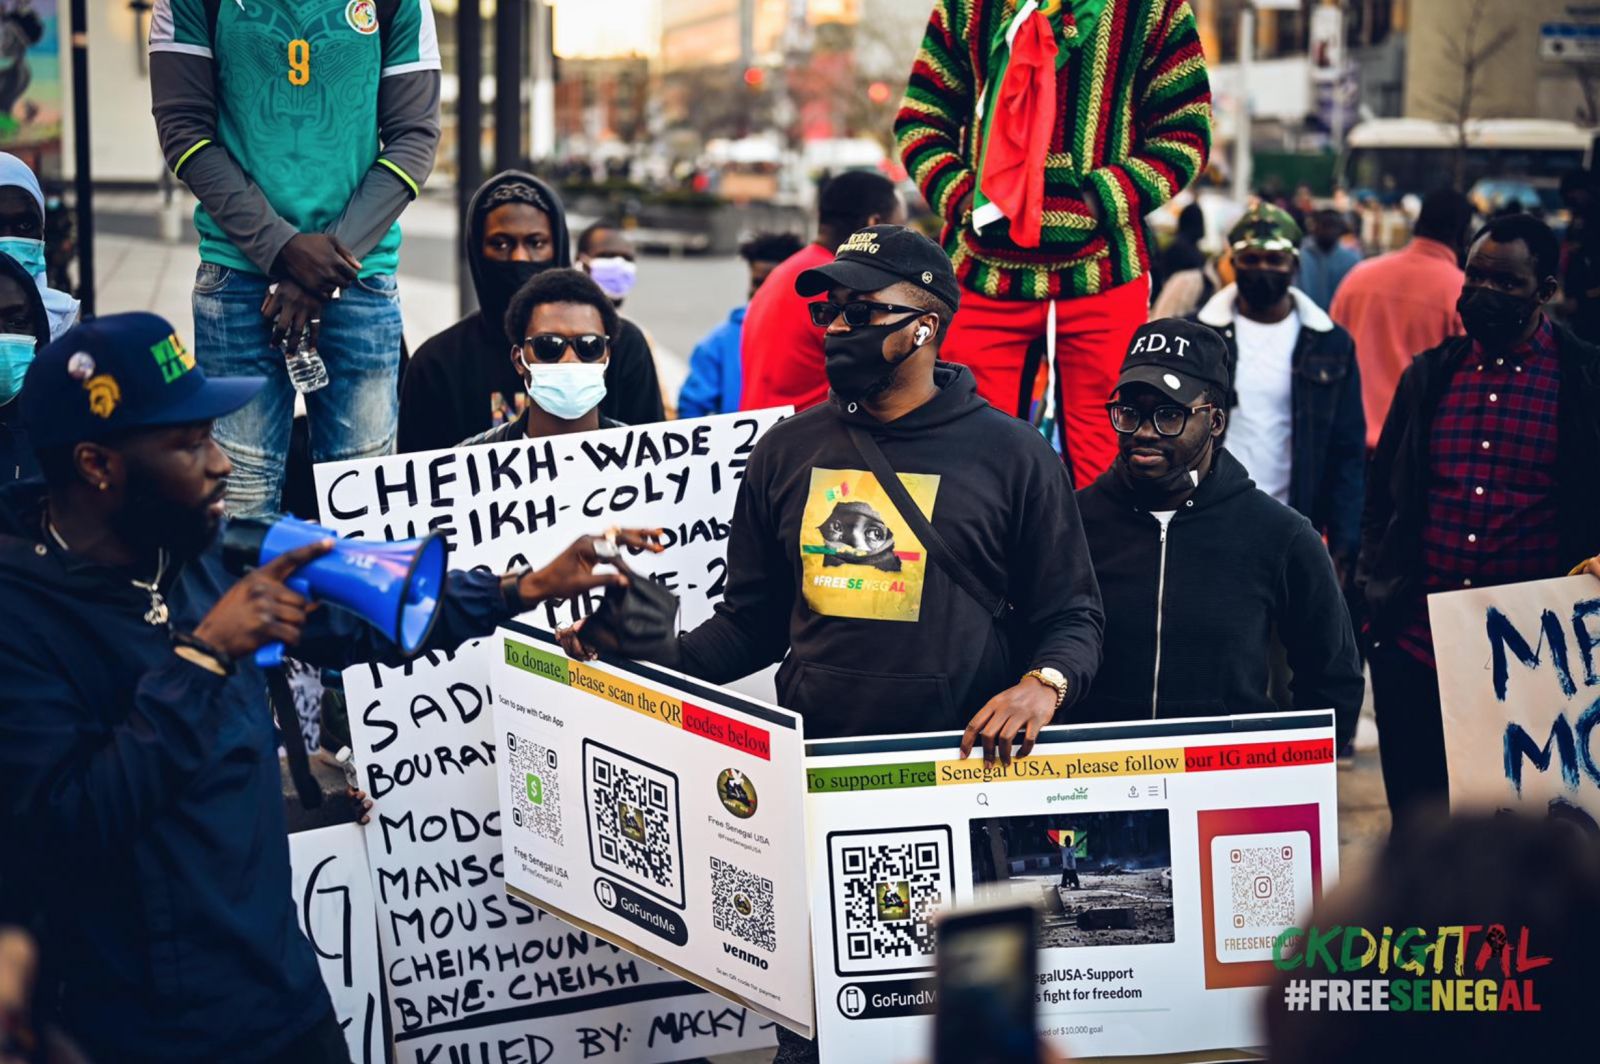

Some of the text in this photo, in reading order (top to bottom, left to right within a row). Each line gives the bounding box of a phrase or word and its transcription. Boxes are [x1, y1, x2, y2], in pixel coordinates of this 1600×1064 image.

[288, 38, 310, 86] 9
[1131, 333, 1190, 357] F.D.T
[505, 643, 519, 664] To
[568, 667, 606, 694] please
[608, 685, 634, 706] scan
[638, 692, 657, 714] the
[660, 700, 682, 725] QR
[686, 714, 724, 738] codes
[728, 722, 769, 754] below
[516, 703, 526, 715] pay
[526, 706, 538, 718] with
[538, 710, 552, 723] Cash
[552, 716, 564, 729] App
[807, 773, 825, 790] To
[831, 769, 894, 792] support
[900, 767, 935, 784] Free
[941, 763, 1008, 783] Senegal
[1014, 760, 1061, 779] USA,
[1066, 758, 1119, 779] please
[1125, 753, 1179, 772] follow
[1186, 756, 1213, 769] our
[1219, 749, 1241, 767] IG
[1246, 746, 1277, 766] and
[1046, 792, 1088, 804] gofundme
[708, 815, 770, 846] Free Senegal USA
[514, 846, 569, 880] Free Senegal USA
[620, 897, 676, 935] GoFundMe
[722, 942, 769, 971] venmo
[508, 960, 640, 1000] CHEIKH
[1043, 989, 1071, 1005] fight
[1073, 987, 1090, 1001] for
[1092, 986, 1142, 1000] freedom
[872, 990, 937, 1008] GoFundM
[576, 1022, 632, 1059] BY:
[648, 1008, 748, 1048] MACKY
[1060, 1025, 1088, 1036] $10,000
[1089, 1025, 1104, 1035] goal
